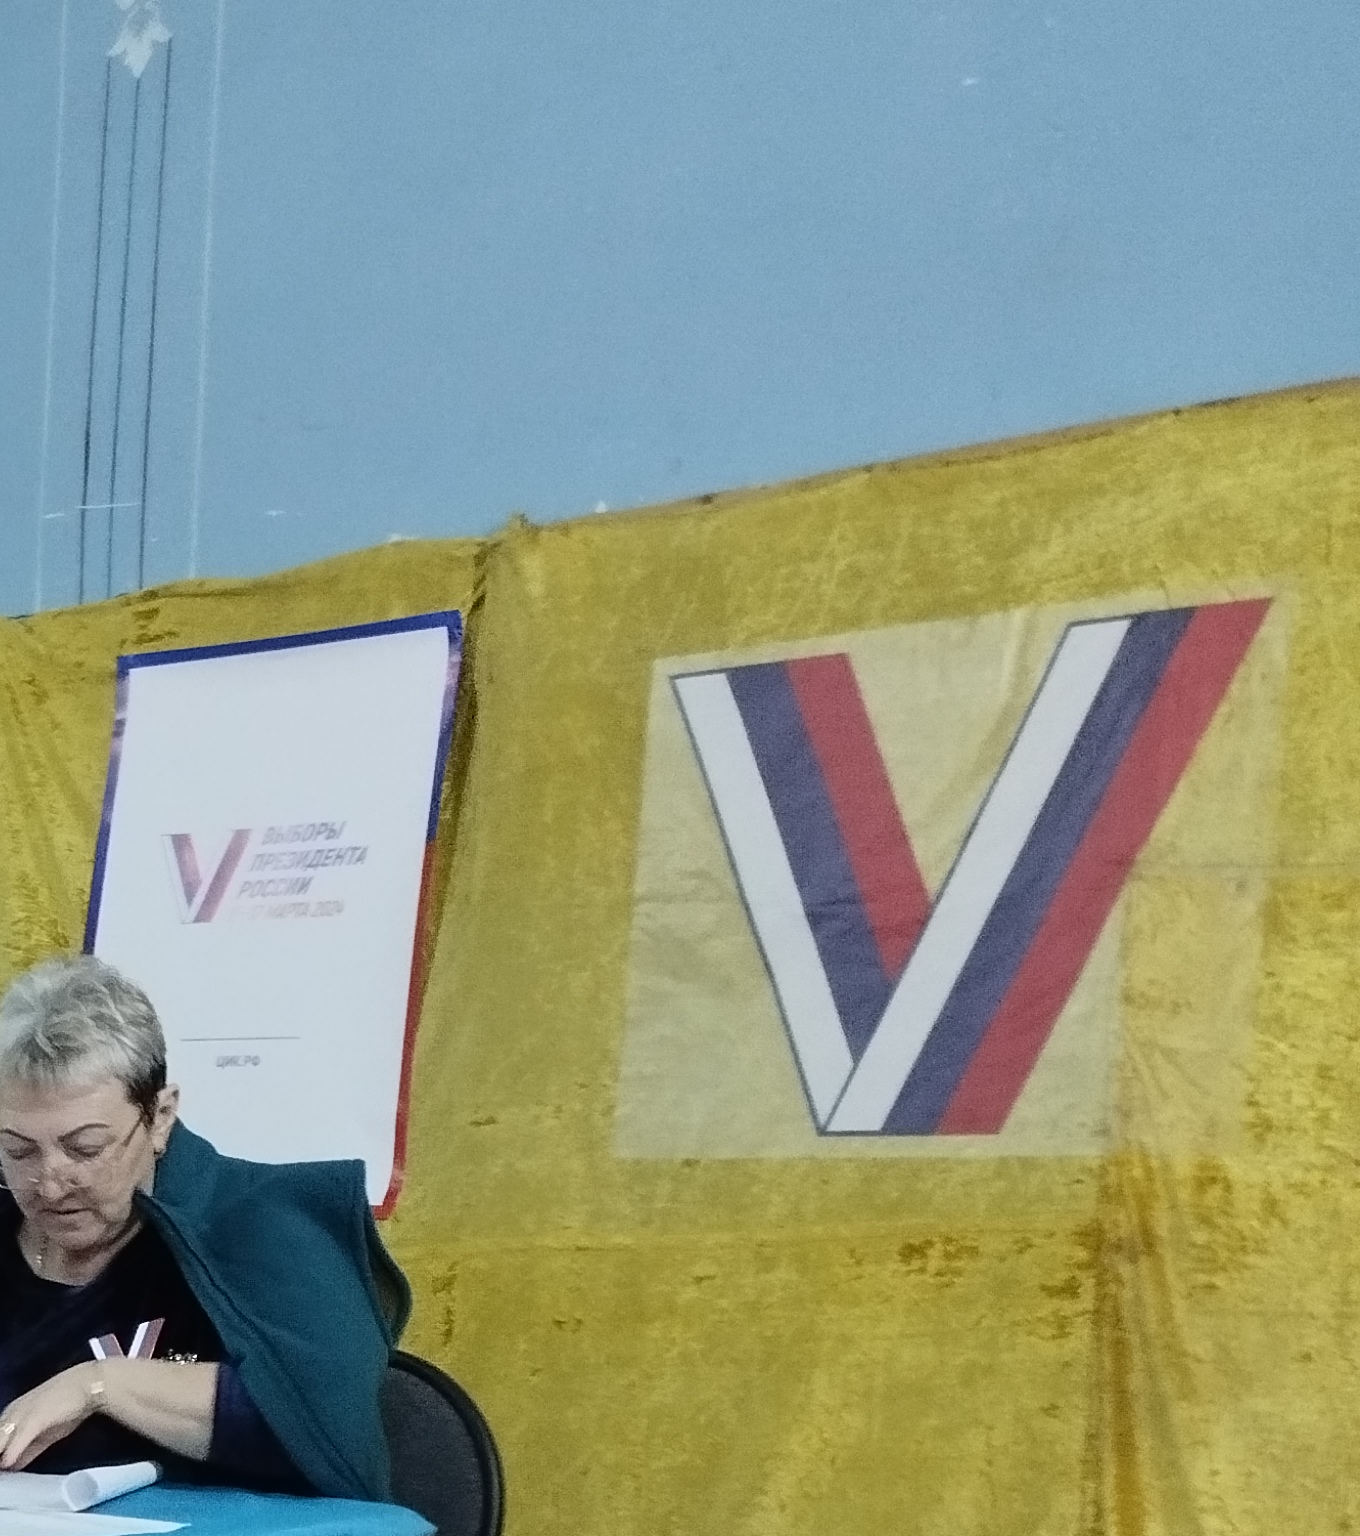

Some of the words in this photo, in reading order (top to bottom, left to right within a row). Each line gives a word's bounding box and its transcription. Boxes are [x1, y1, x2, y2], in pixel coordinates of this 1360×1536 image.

[262, 822, 345, 845] ВЫБОРЫ
[250, 847, 367, 871] ПРЕЗИДЕНТА
[237, 876, 314, 898] РОССИИ
